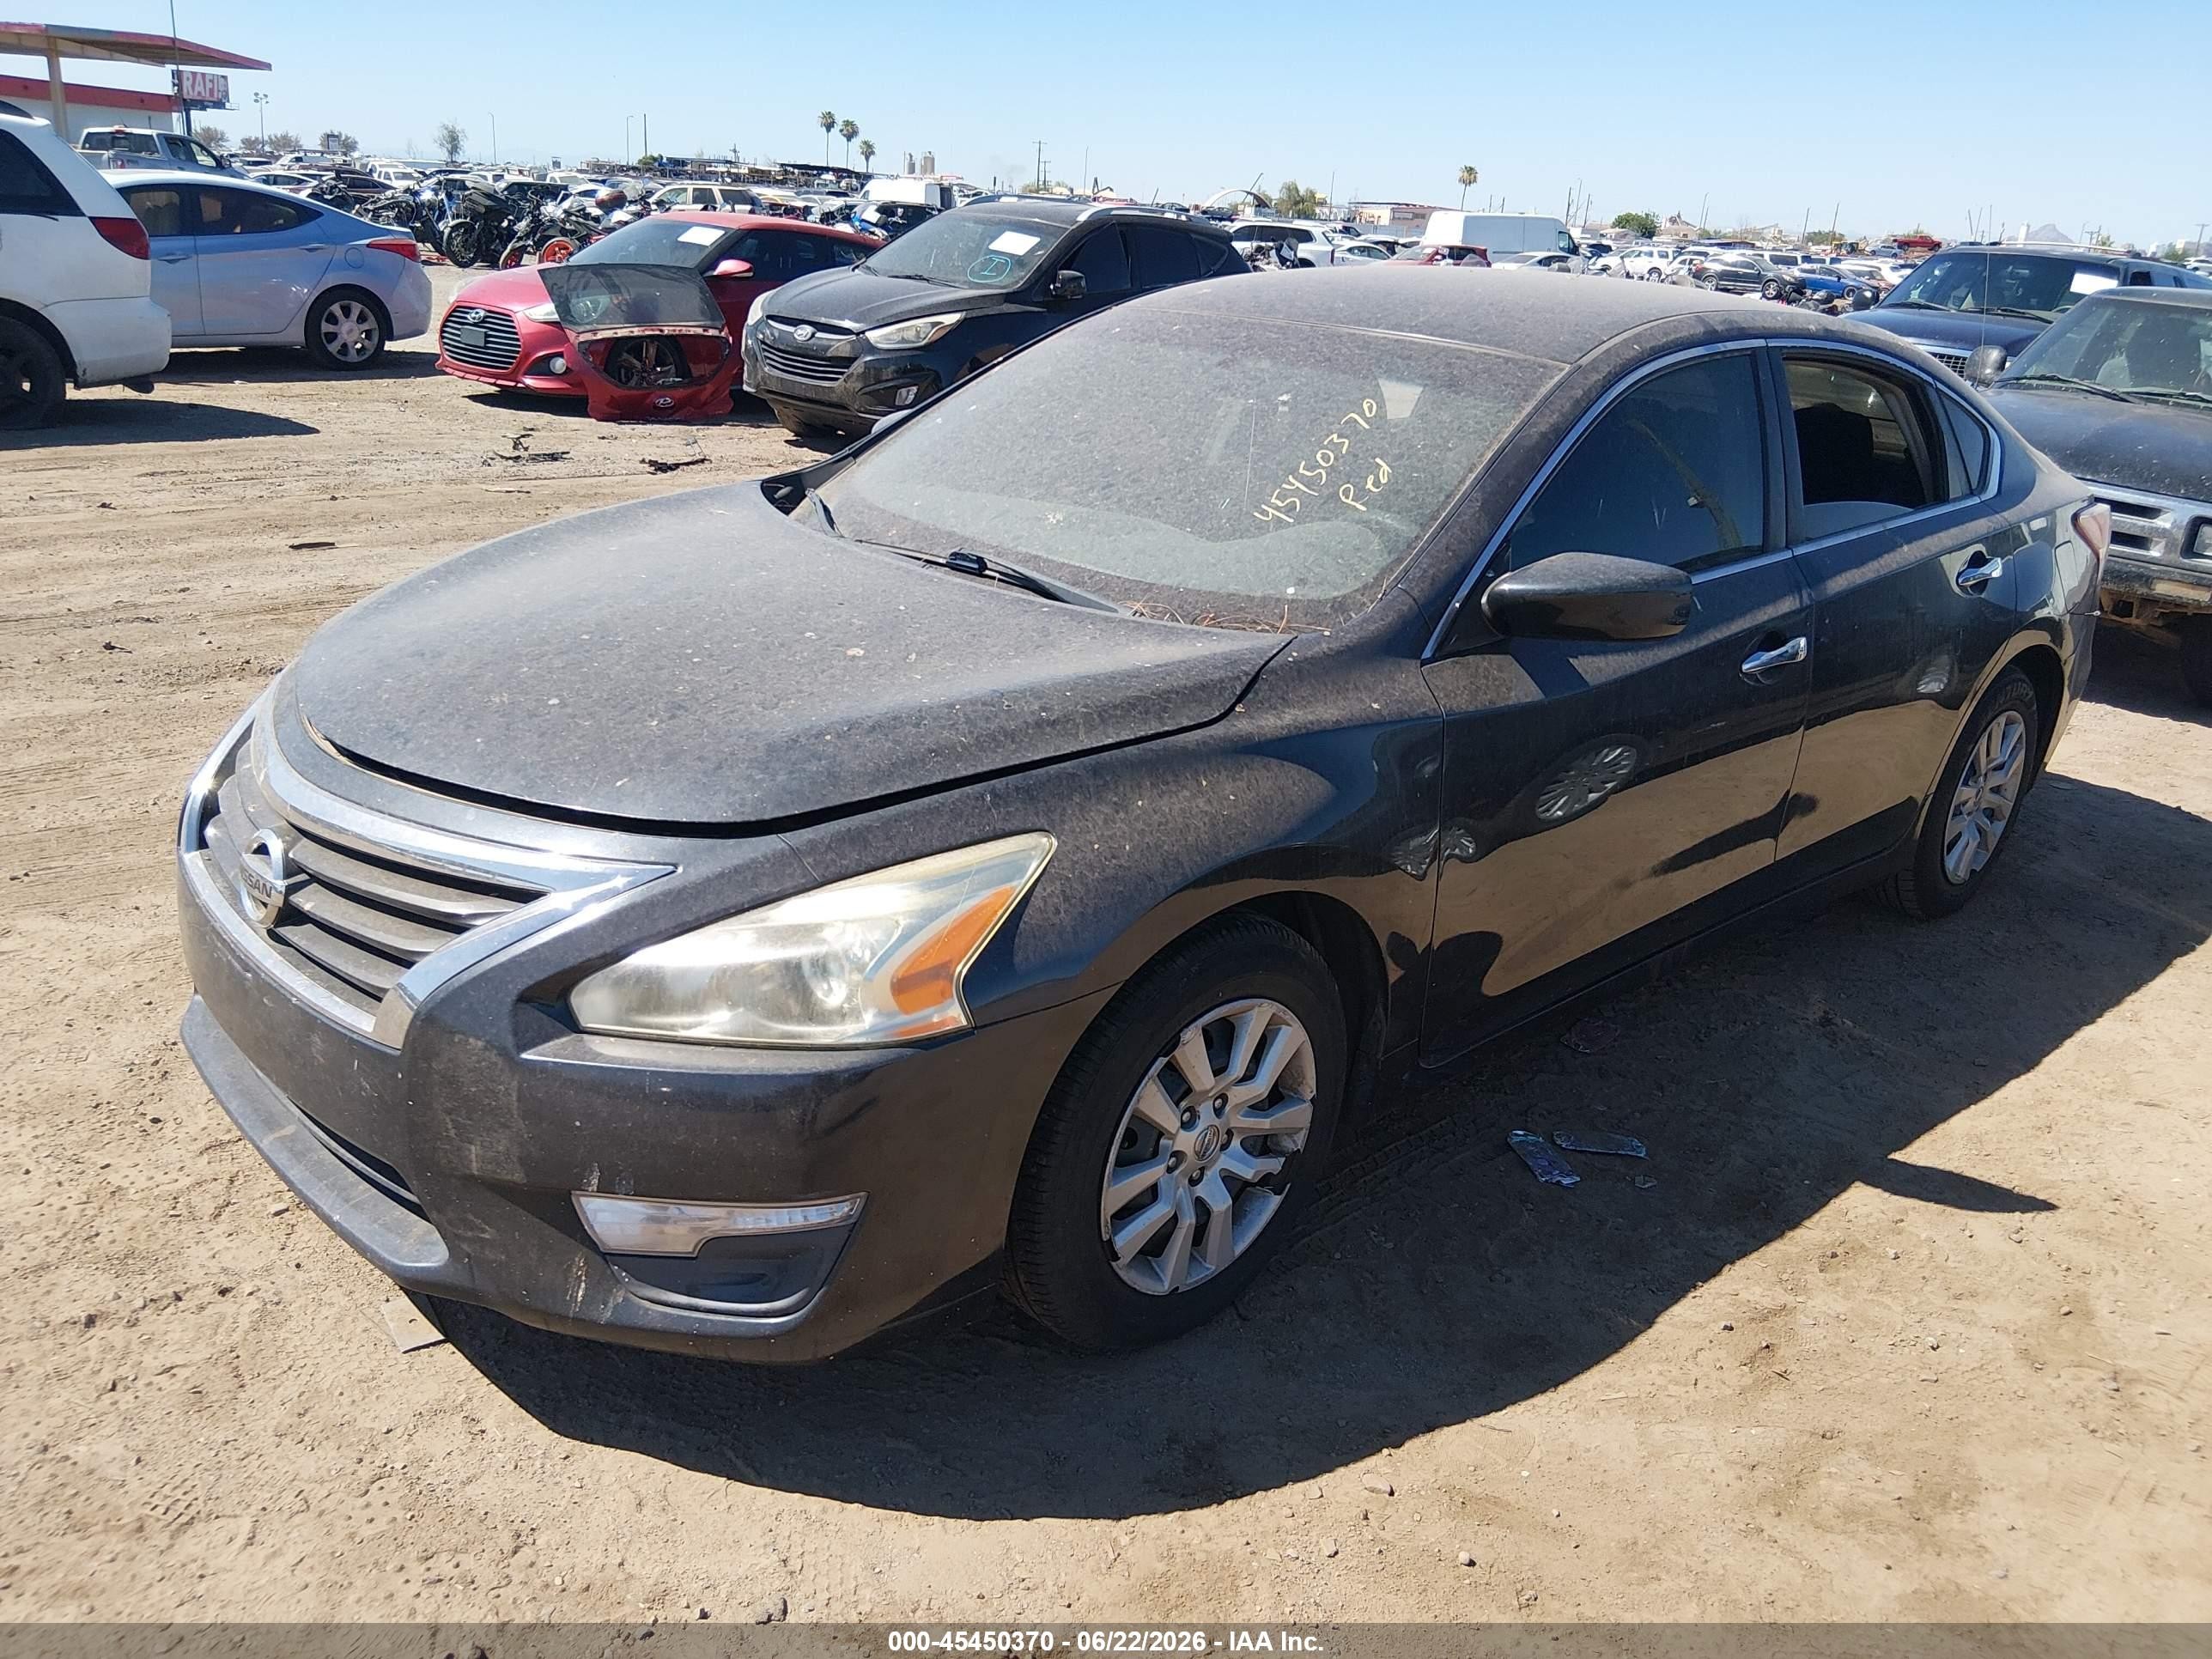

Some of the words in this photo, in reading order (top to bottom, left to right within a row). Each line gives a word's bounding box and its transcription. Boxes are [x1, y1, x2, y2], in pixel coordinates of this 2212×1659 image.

[183, 71, 218, 98] RAFI
[1253, 398, 1376, 523] 45450370
[1339, 457, 1392, 511] Red
[240, 867, 273, 899] ISSAN
